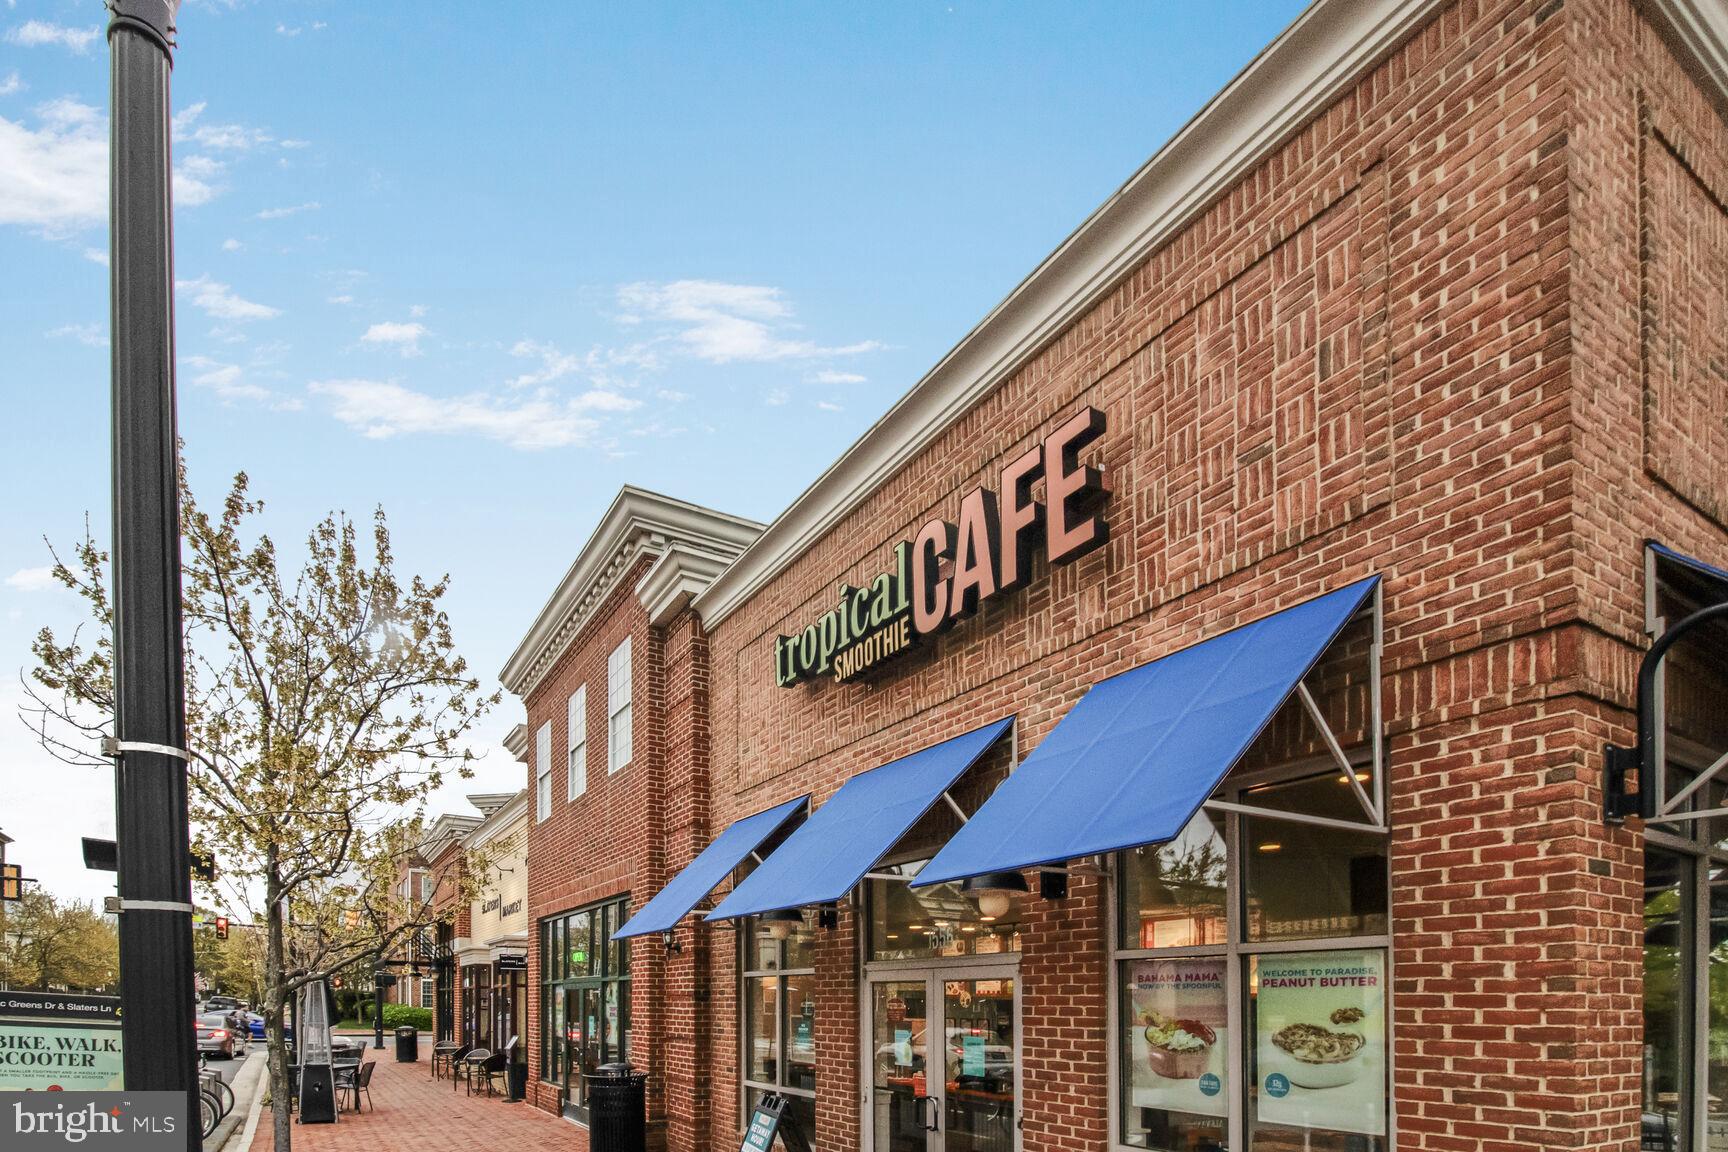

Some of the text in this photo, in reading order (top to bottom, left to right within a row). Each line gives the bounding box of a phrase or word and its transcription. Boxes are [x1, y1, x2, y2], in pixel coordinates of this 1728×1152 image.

[911, 406, 1096, 634] CAFE
[774, 540, 910, 688] tropical
[833, 616, 911, 683] SMOOTHIE
[1137, 974, 1182, 983] BAHAMA
[1262, 969, 1308, 977] WELCOME
[1311, 968, 1323, 976] TO
[1262, 976, 1377, 988] PEANUT BUTTER
[8, 1000, 43, 1009] Greens
[66, 1003, 99, 1011] Slaters
